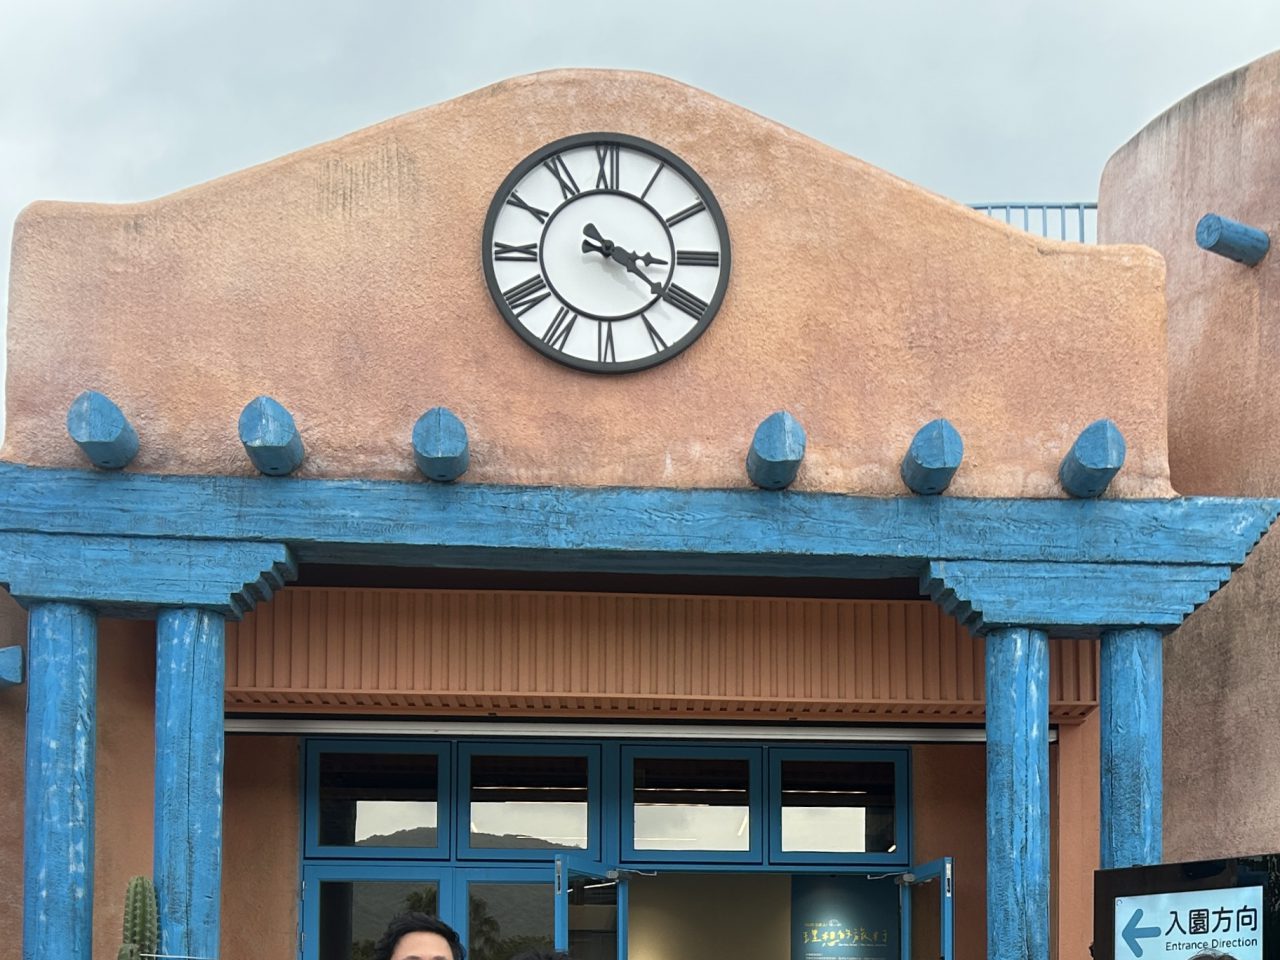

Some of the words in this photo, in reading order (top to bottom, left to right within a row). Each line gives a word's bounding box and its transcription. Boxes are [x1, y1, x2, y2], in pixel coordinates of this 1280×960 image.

[1164, 904, 1257, 937] 入園方向
[1165, 939, 1209, 951] Entrance
[1211, 938, 1258, 949] Direction
